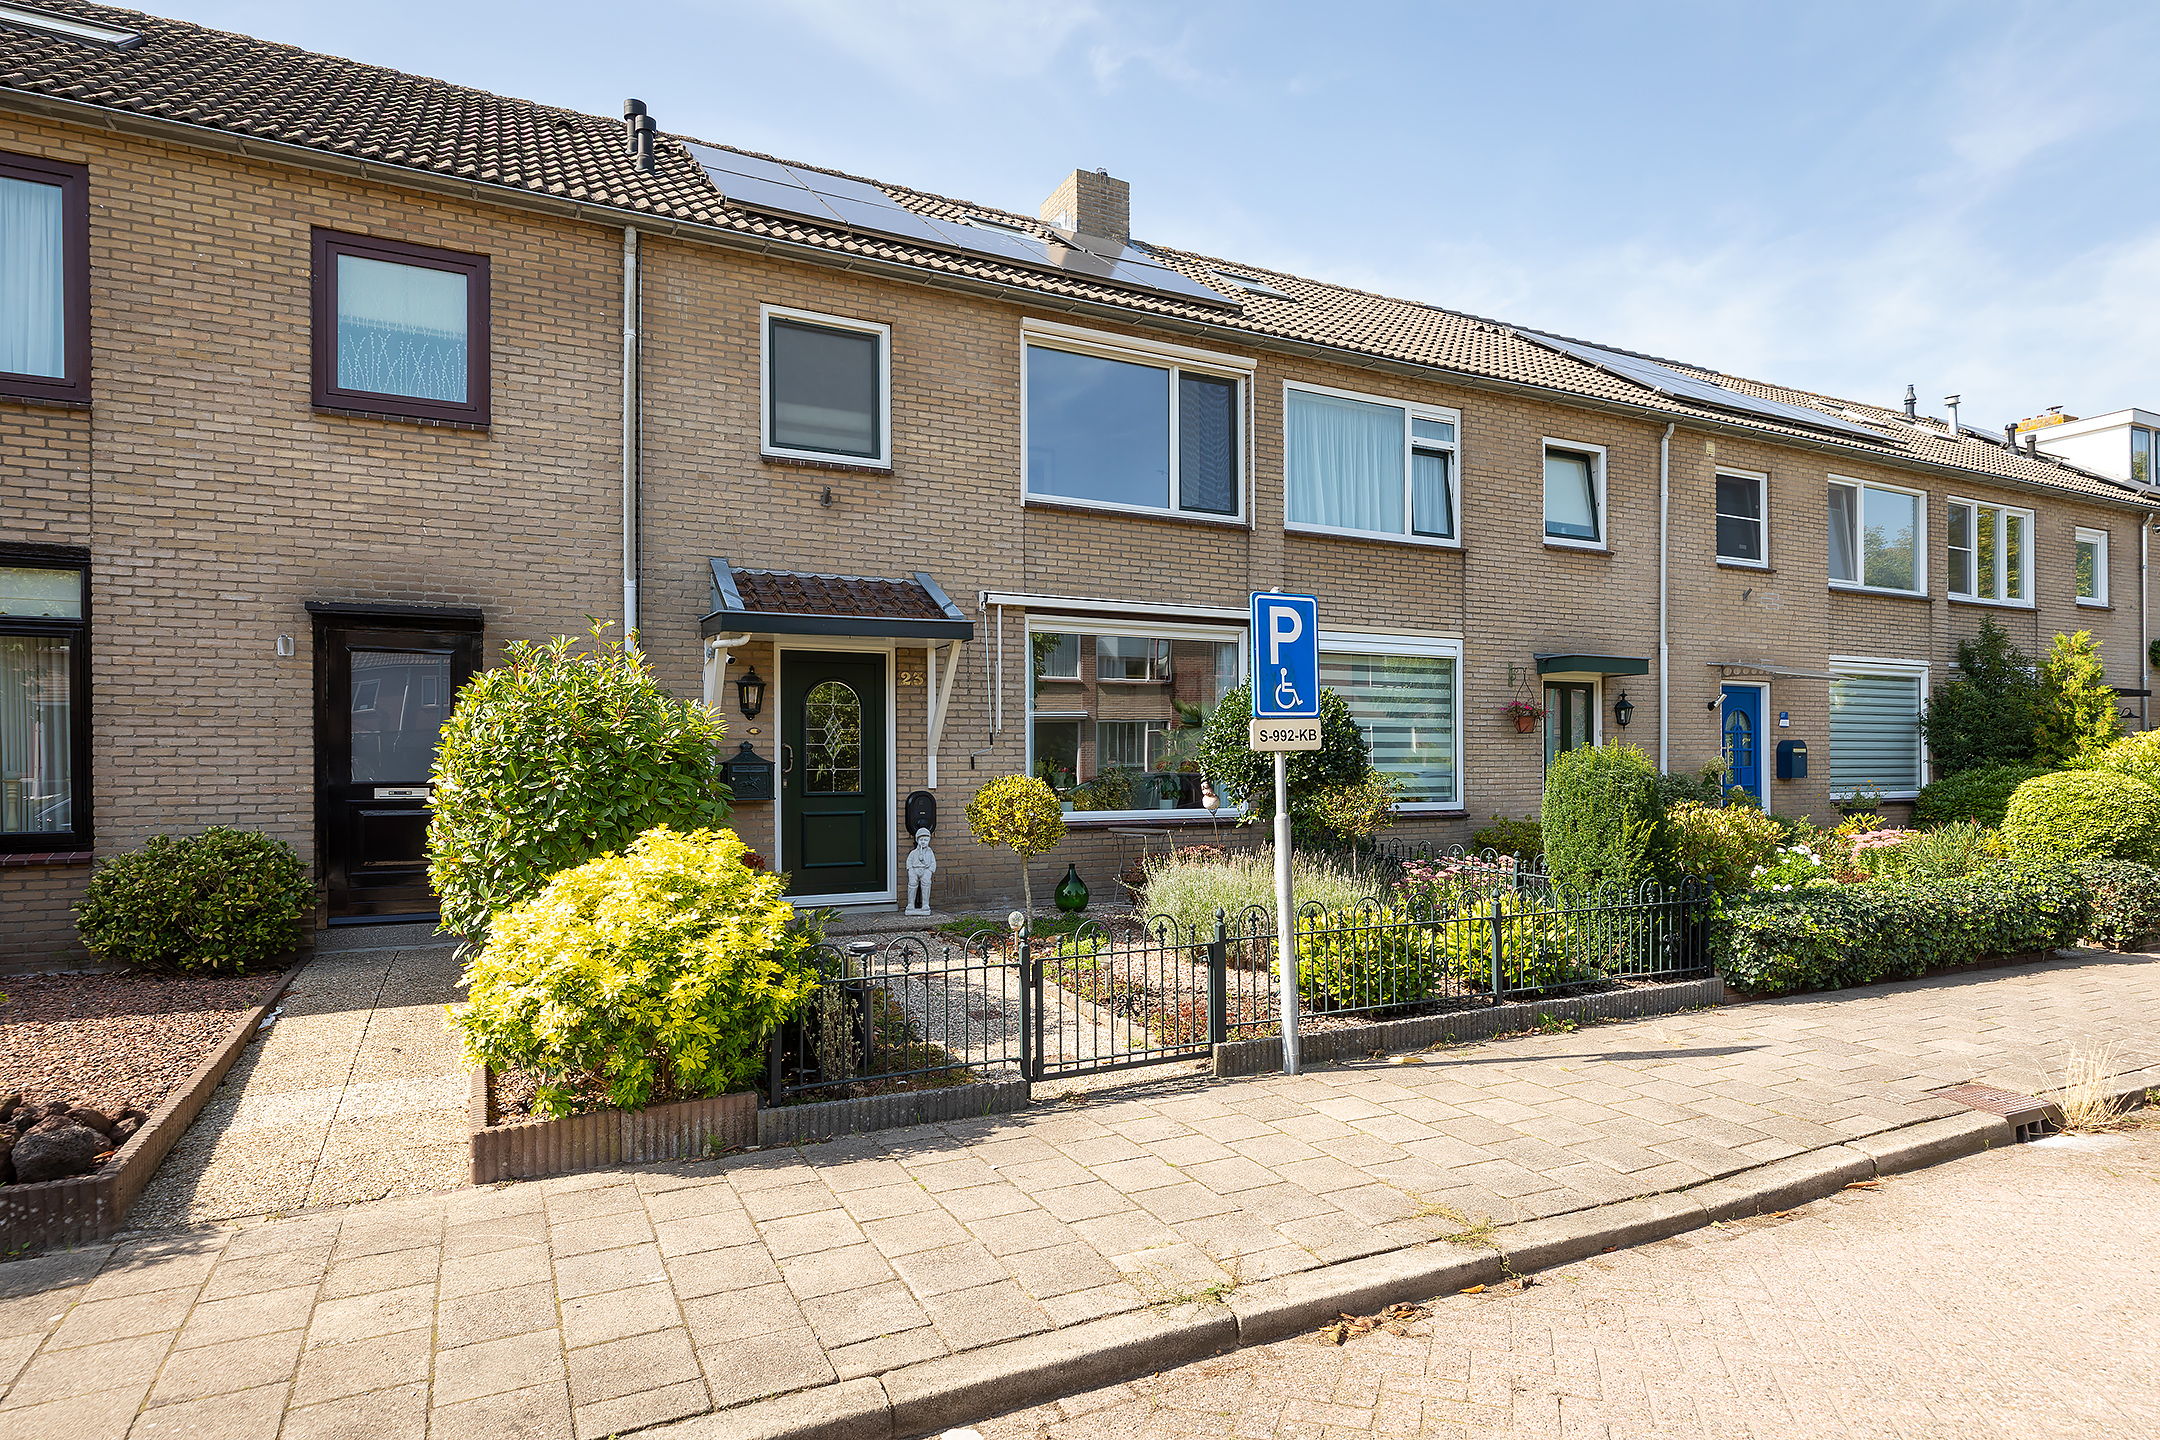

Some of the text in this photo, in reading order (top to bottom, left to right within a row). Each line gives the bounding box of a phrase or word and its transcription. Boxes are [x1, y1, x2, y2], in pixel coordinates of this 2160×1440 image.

[1269, 605, 1303, 665] P
[900, 671, 924, 686] 23
[1259, 728, 1318, 743] S-992-KB
